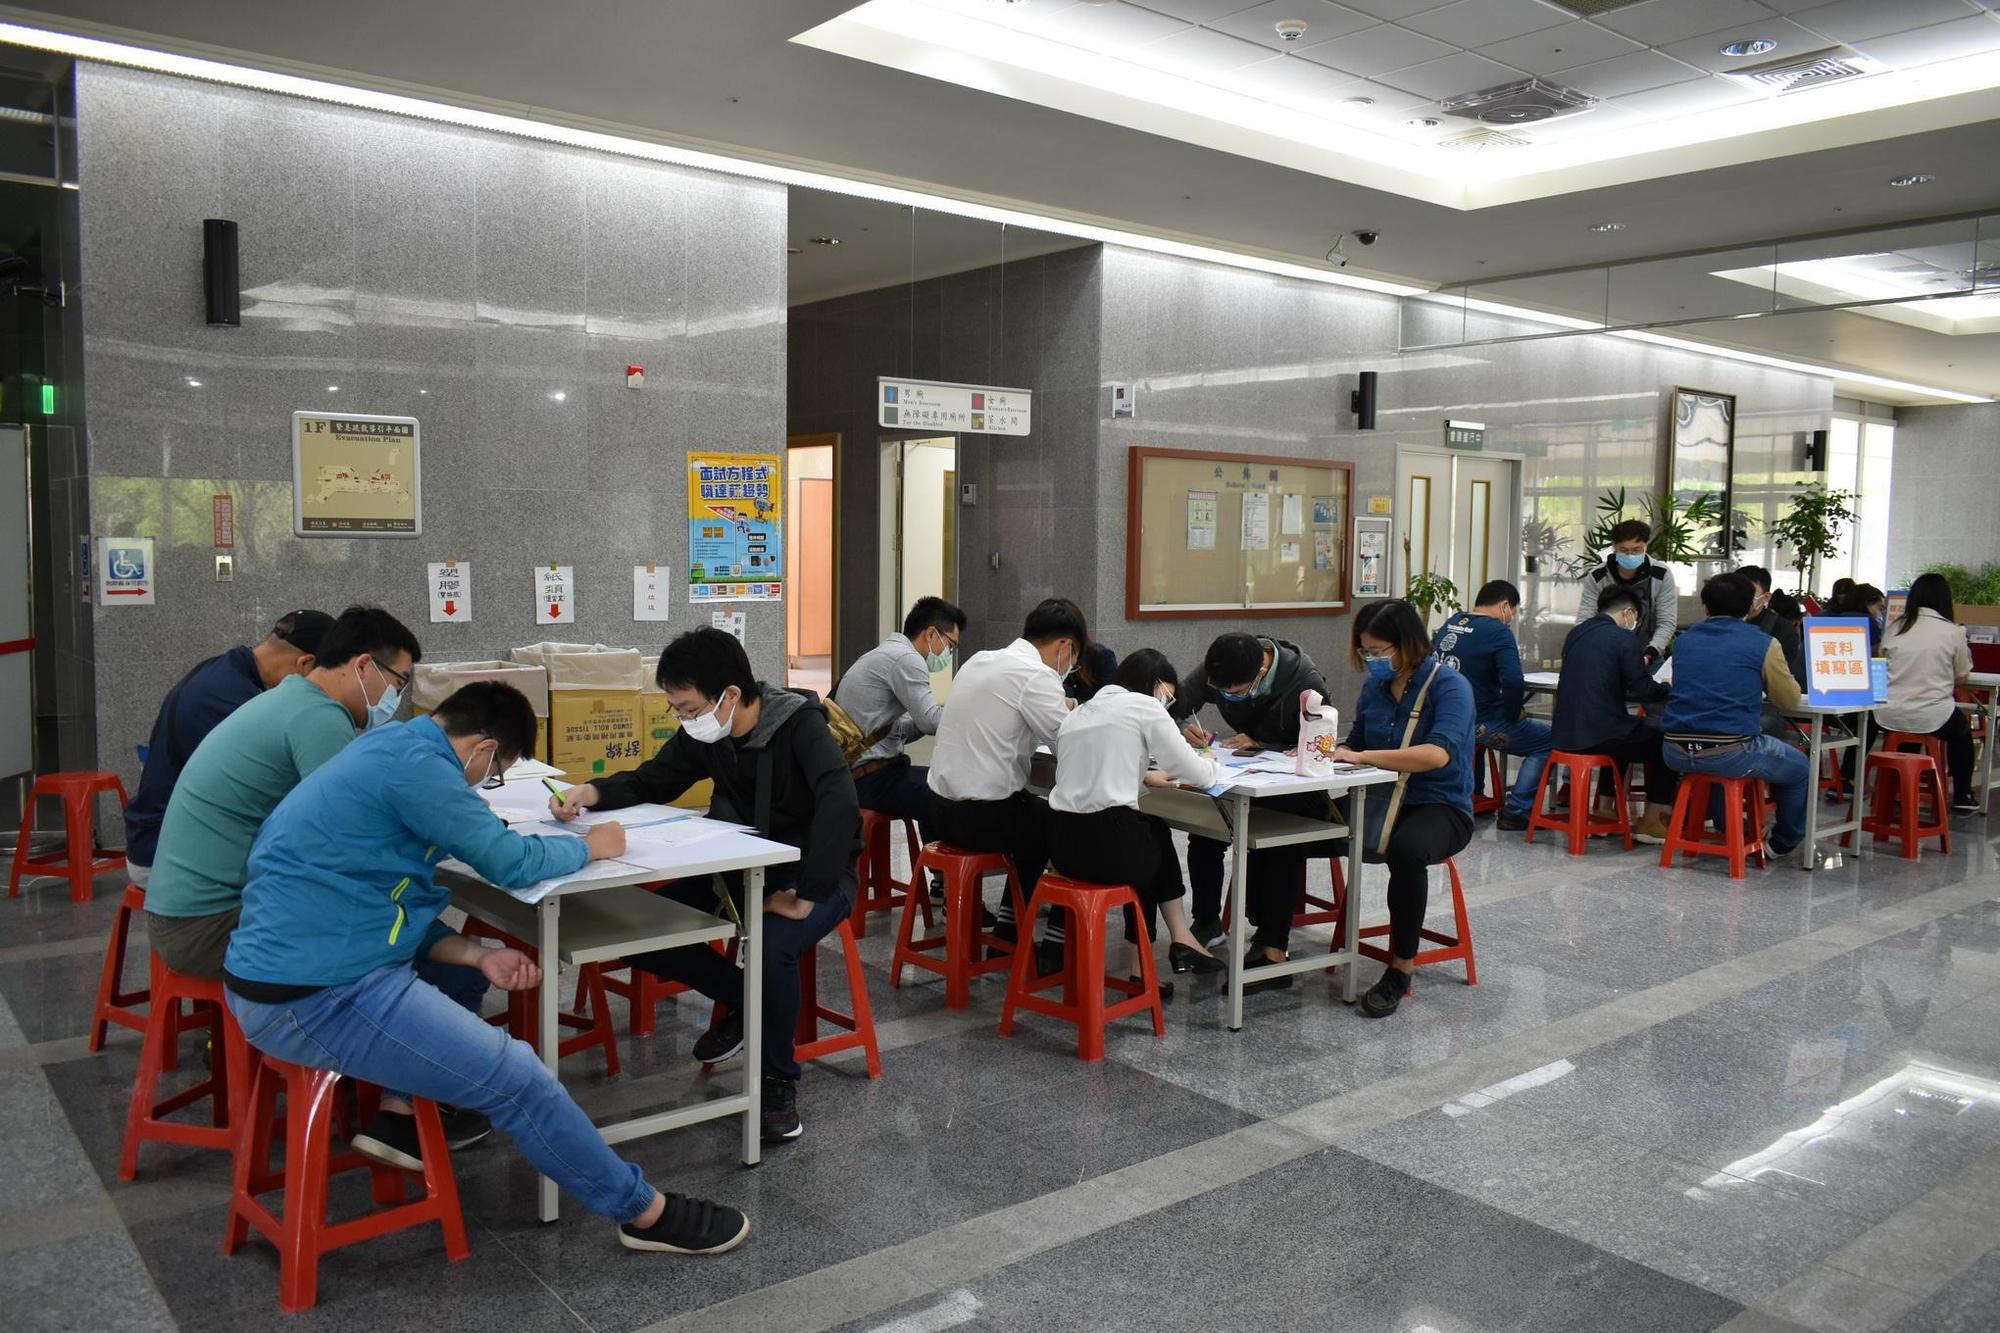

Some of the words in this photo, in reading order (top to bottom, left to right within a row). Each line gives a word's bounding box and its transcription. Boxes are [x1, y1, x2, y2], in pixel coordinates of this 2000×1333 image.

[700, 466, 768, 481] 面試方程式
[1822, 641, 1855, 656] 資料
[1816, 660, 1864, 675] 填寫區
[606, 740, 641, 760] 舒綿
